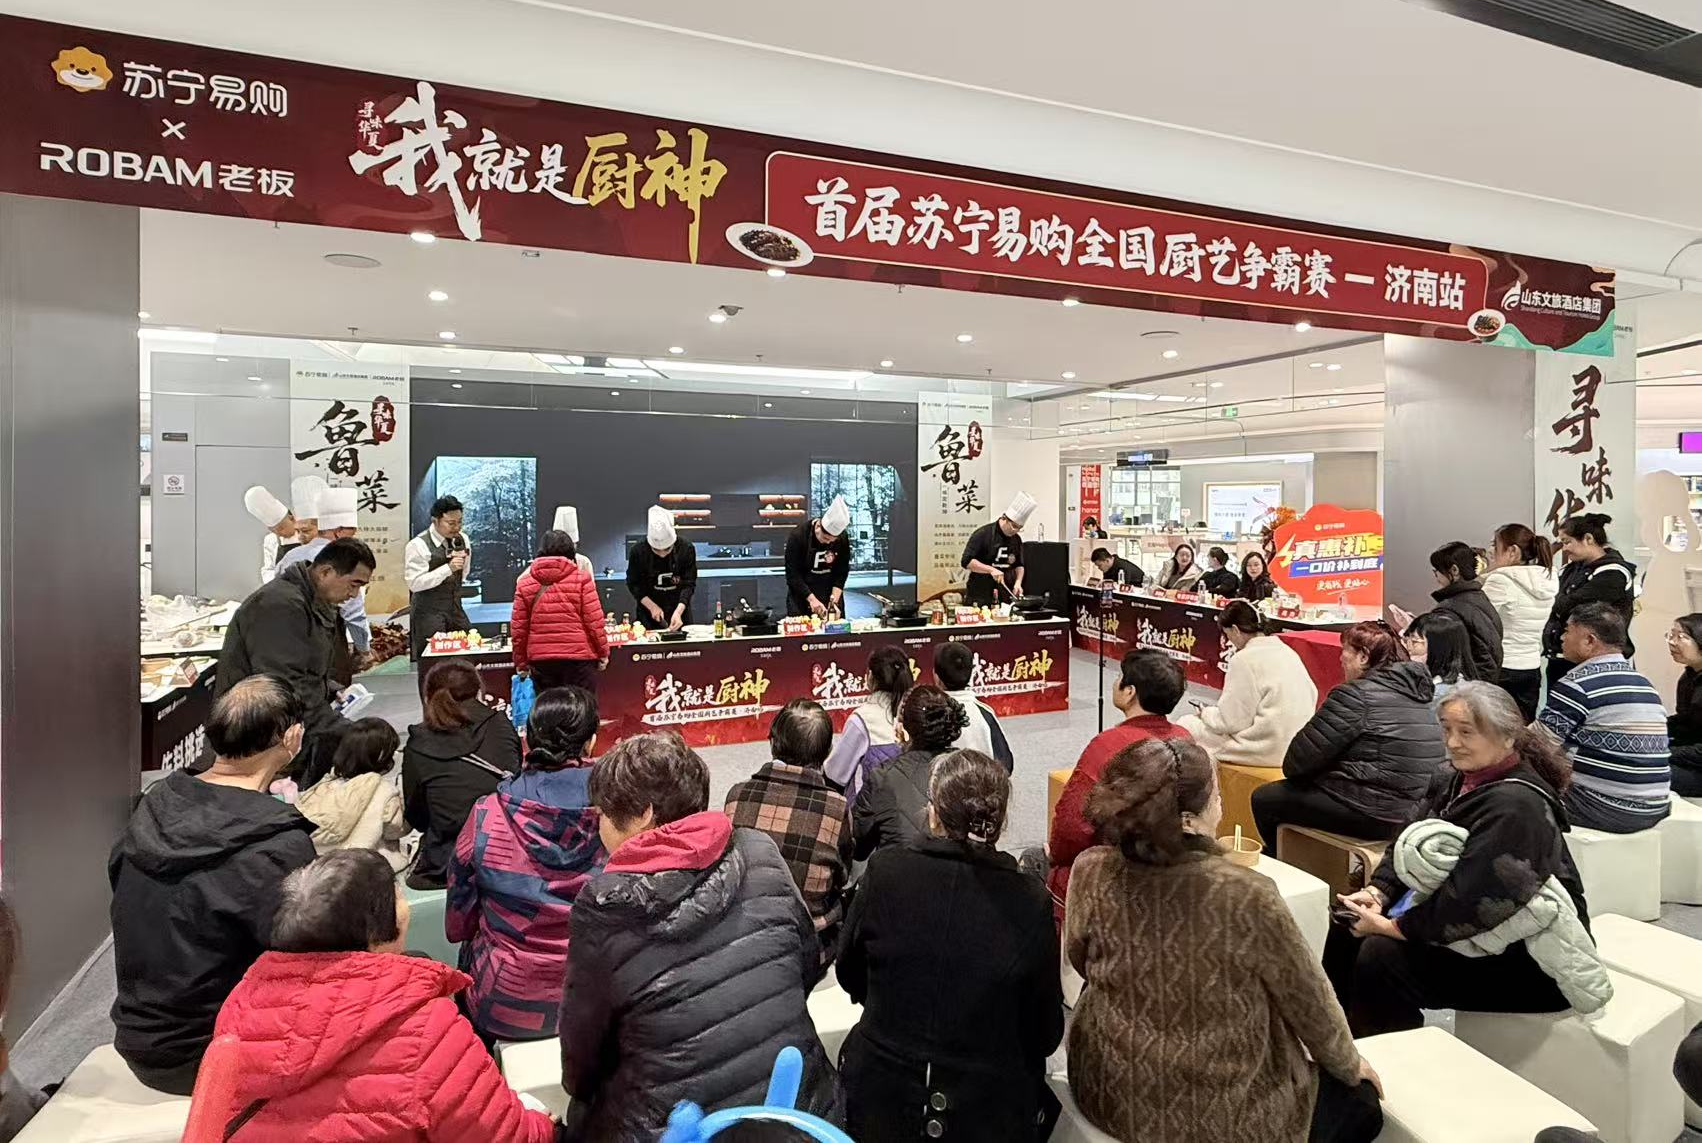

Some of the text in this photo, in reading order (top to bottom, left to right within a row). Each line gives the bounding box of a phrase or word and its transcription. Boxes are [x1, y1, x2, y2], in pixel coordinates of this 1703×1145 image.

[122, 61, 289, 118] 苏宁易购
[40, 142, 296, 198] ROBAM 老板
[348, 81, 728, 264] 我就是厨神
[1521, 288, 1602, 315] 山东文旅酒店集团
[645, 668, 771, 720] 我就是厨神
